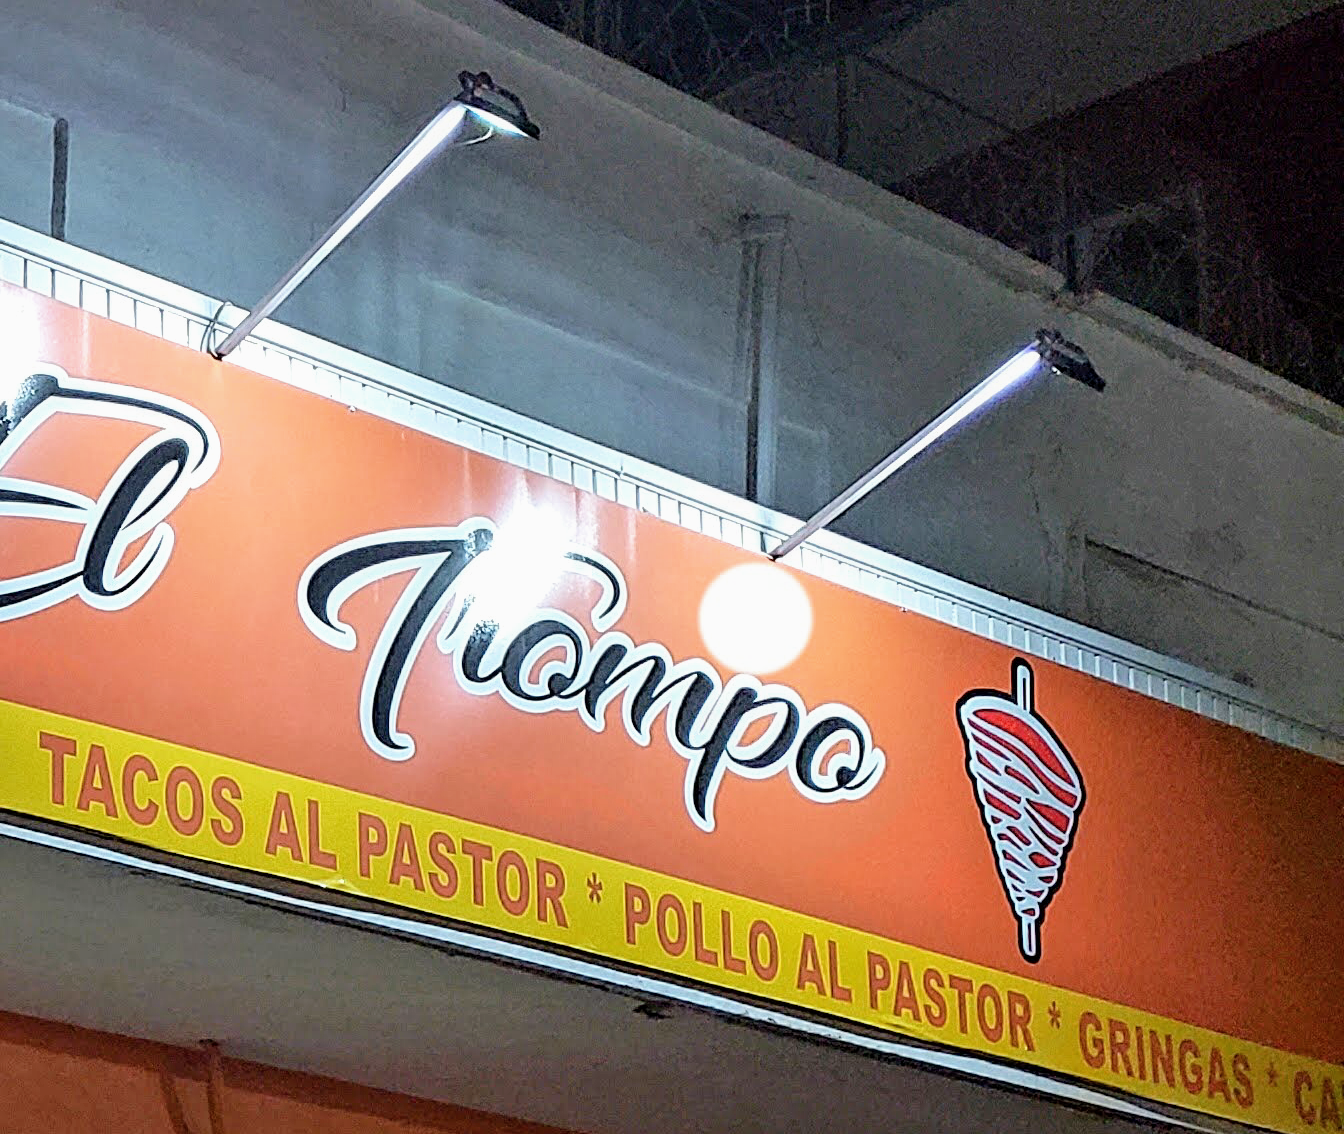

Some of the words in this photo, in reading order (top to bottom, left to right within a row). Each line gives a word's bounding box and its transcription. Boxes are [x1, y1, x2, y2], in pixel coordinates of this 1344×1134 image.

[302, 522, 882, 829] Trompo
[39, 731, 244, 846] TACOS
[266, 791, 337, 872] AL
[357, 812, 569, 929] PASTOR
[625, 883, 779, 982] POLLO
[796, 933, 853, 1002] AL
[869, 953, 1035, 1052] PASTOR
[1079, 1011, 1254, 1109] GRINGAS
[1293, 1070, 1344, 1130] CA
